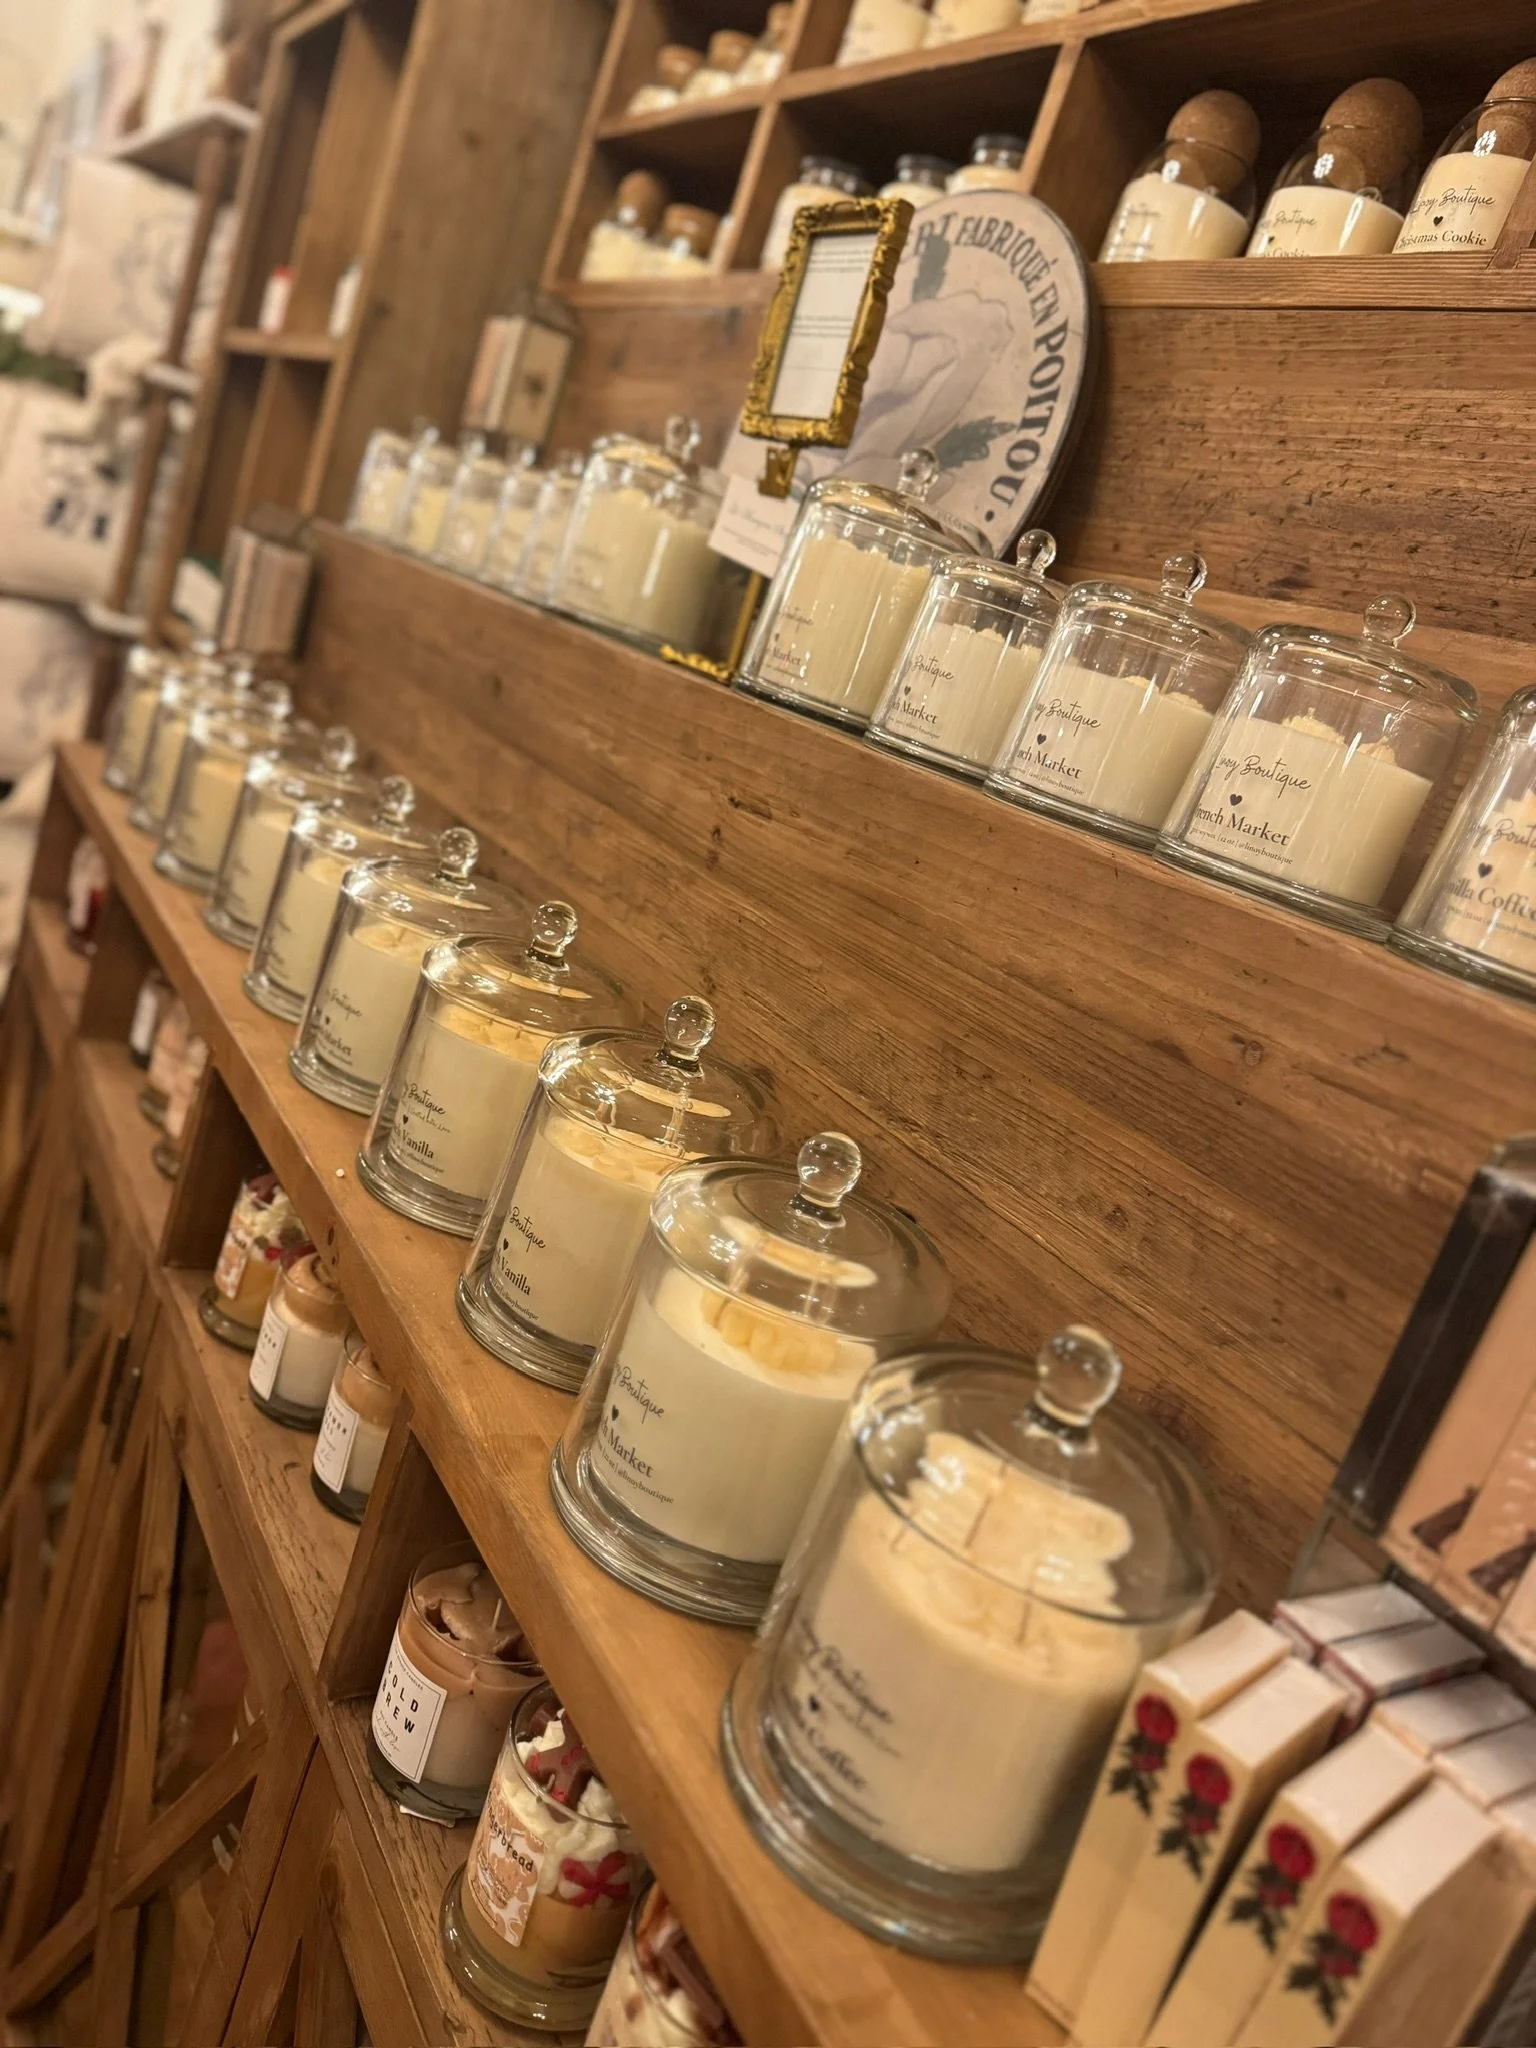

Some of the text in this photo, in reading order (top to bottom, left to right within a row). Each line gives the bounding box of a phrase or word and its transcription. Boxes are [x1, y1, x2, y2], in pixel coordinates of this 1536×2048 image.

[1438, 185, 1496, 215] Boutique
[954, 215, 1059, 294] FABRIQUÉ
[1441, 230, 1487, 246] Cookie
[1029, 281, 1060, 329] EN
[989, 317, 1069, 509] POITOU
[911, 654, 954, 688] Boutique
[901, 700, 938, 725] Market
[1045, 698, 1101, 737] Boutique
[1034, 750, 1083, 779] Market
[1240, 755, 1311, 799] Boutique
[1227, 813, 1290, 846] Market
[1493, 818, 1536, 849] Bout
[408, 1083, 446, 1120] Boutique
[402, 1129, 434, 1159] Vanilla
[509, 1206, 546, 1253] Boutique
[501, 1256, 531, 1296] Vanilla
[619, 1366, 665, 1425] Boutique
[608, 1427, 654, 1478] Market
[387, 1660, 419, 1713] COLD
[488, 1790, 534, 1872] gerbread
